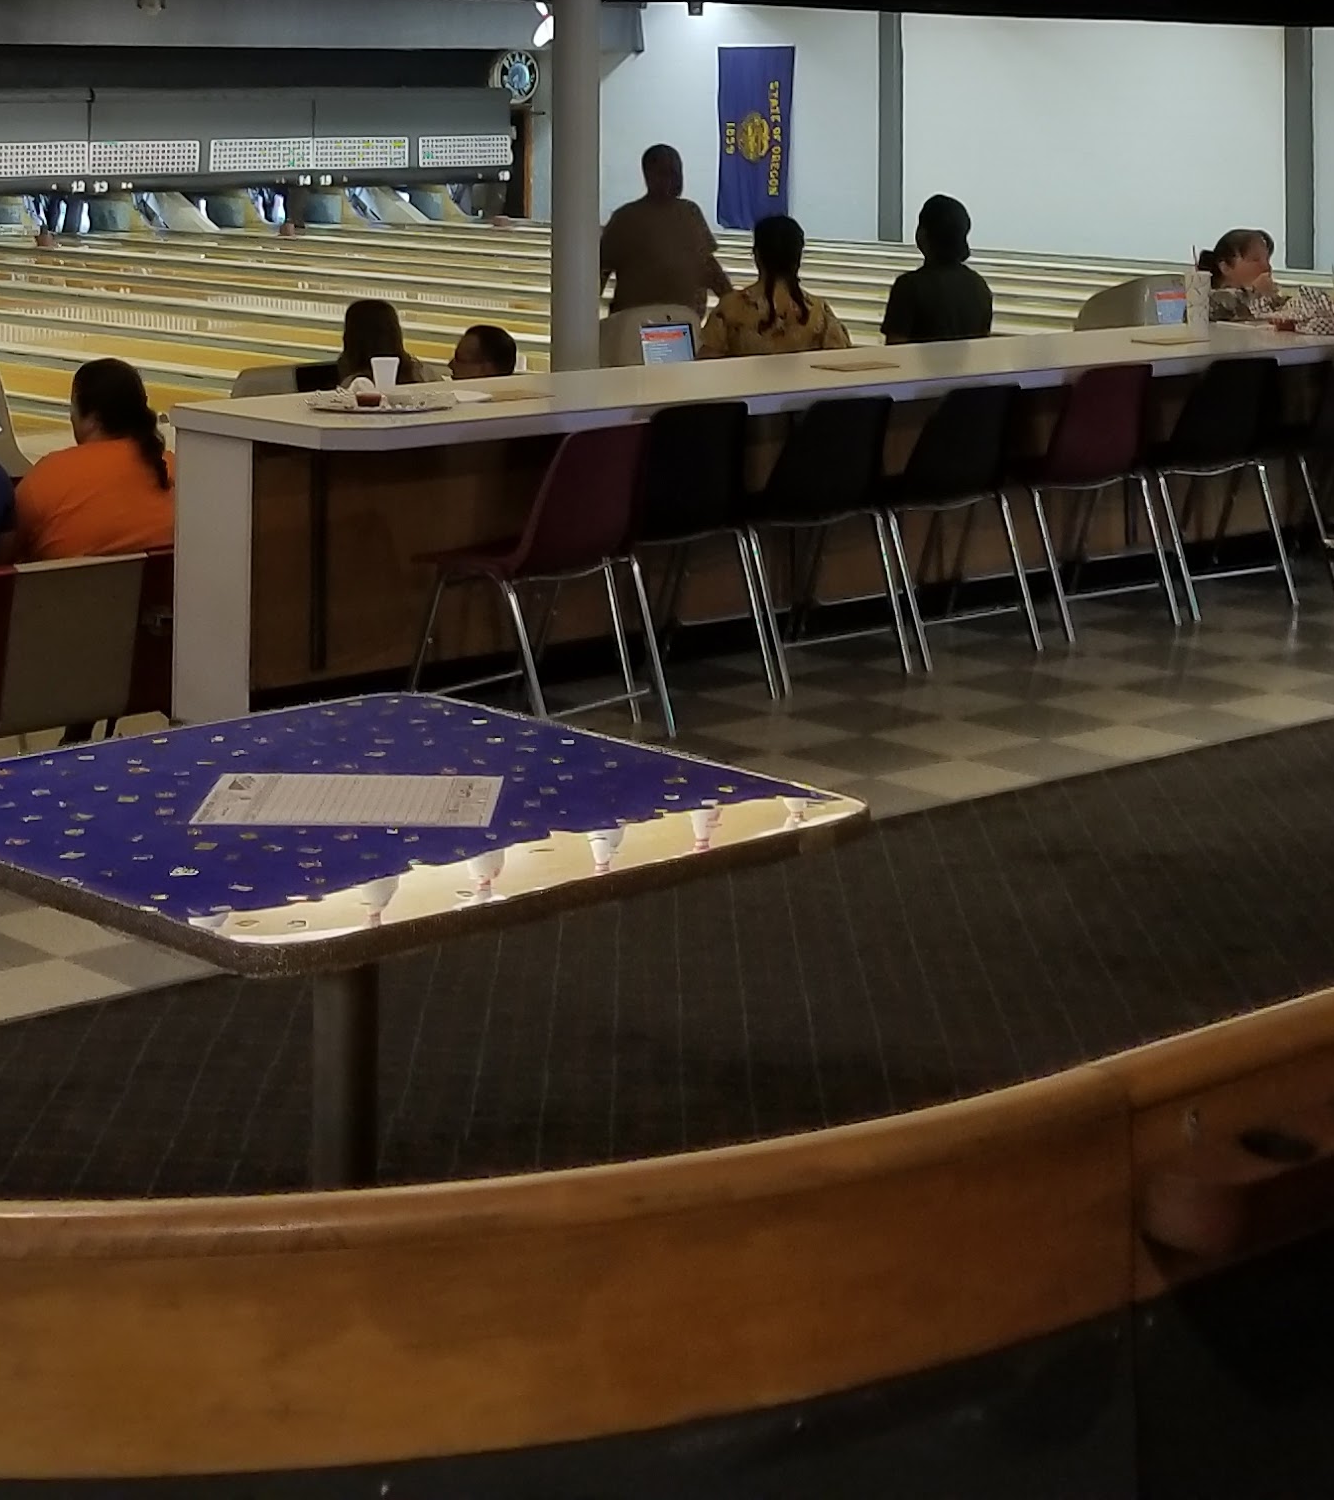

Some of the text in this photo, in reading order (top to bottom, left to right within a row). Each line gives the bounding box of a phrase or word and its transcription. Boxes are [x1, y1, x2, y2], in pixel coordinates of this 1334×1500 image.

[768, 81, 781, 196] STATE OF OREGON
[71, 180, 85, 193] 12
[298, 174, 311, 186] 14
